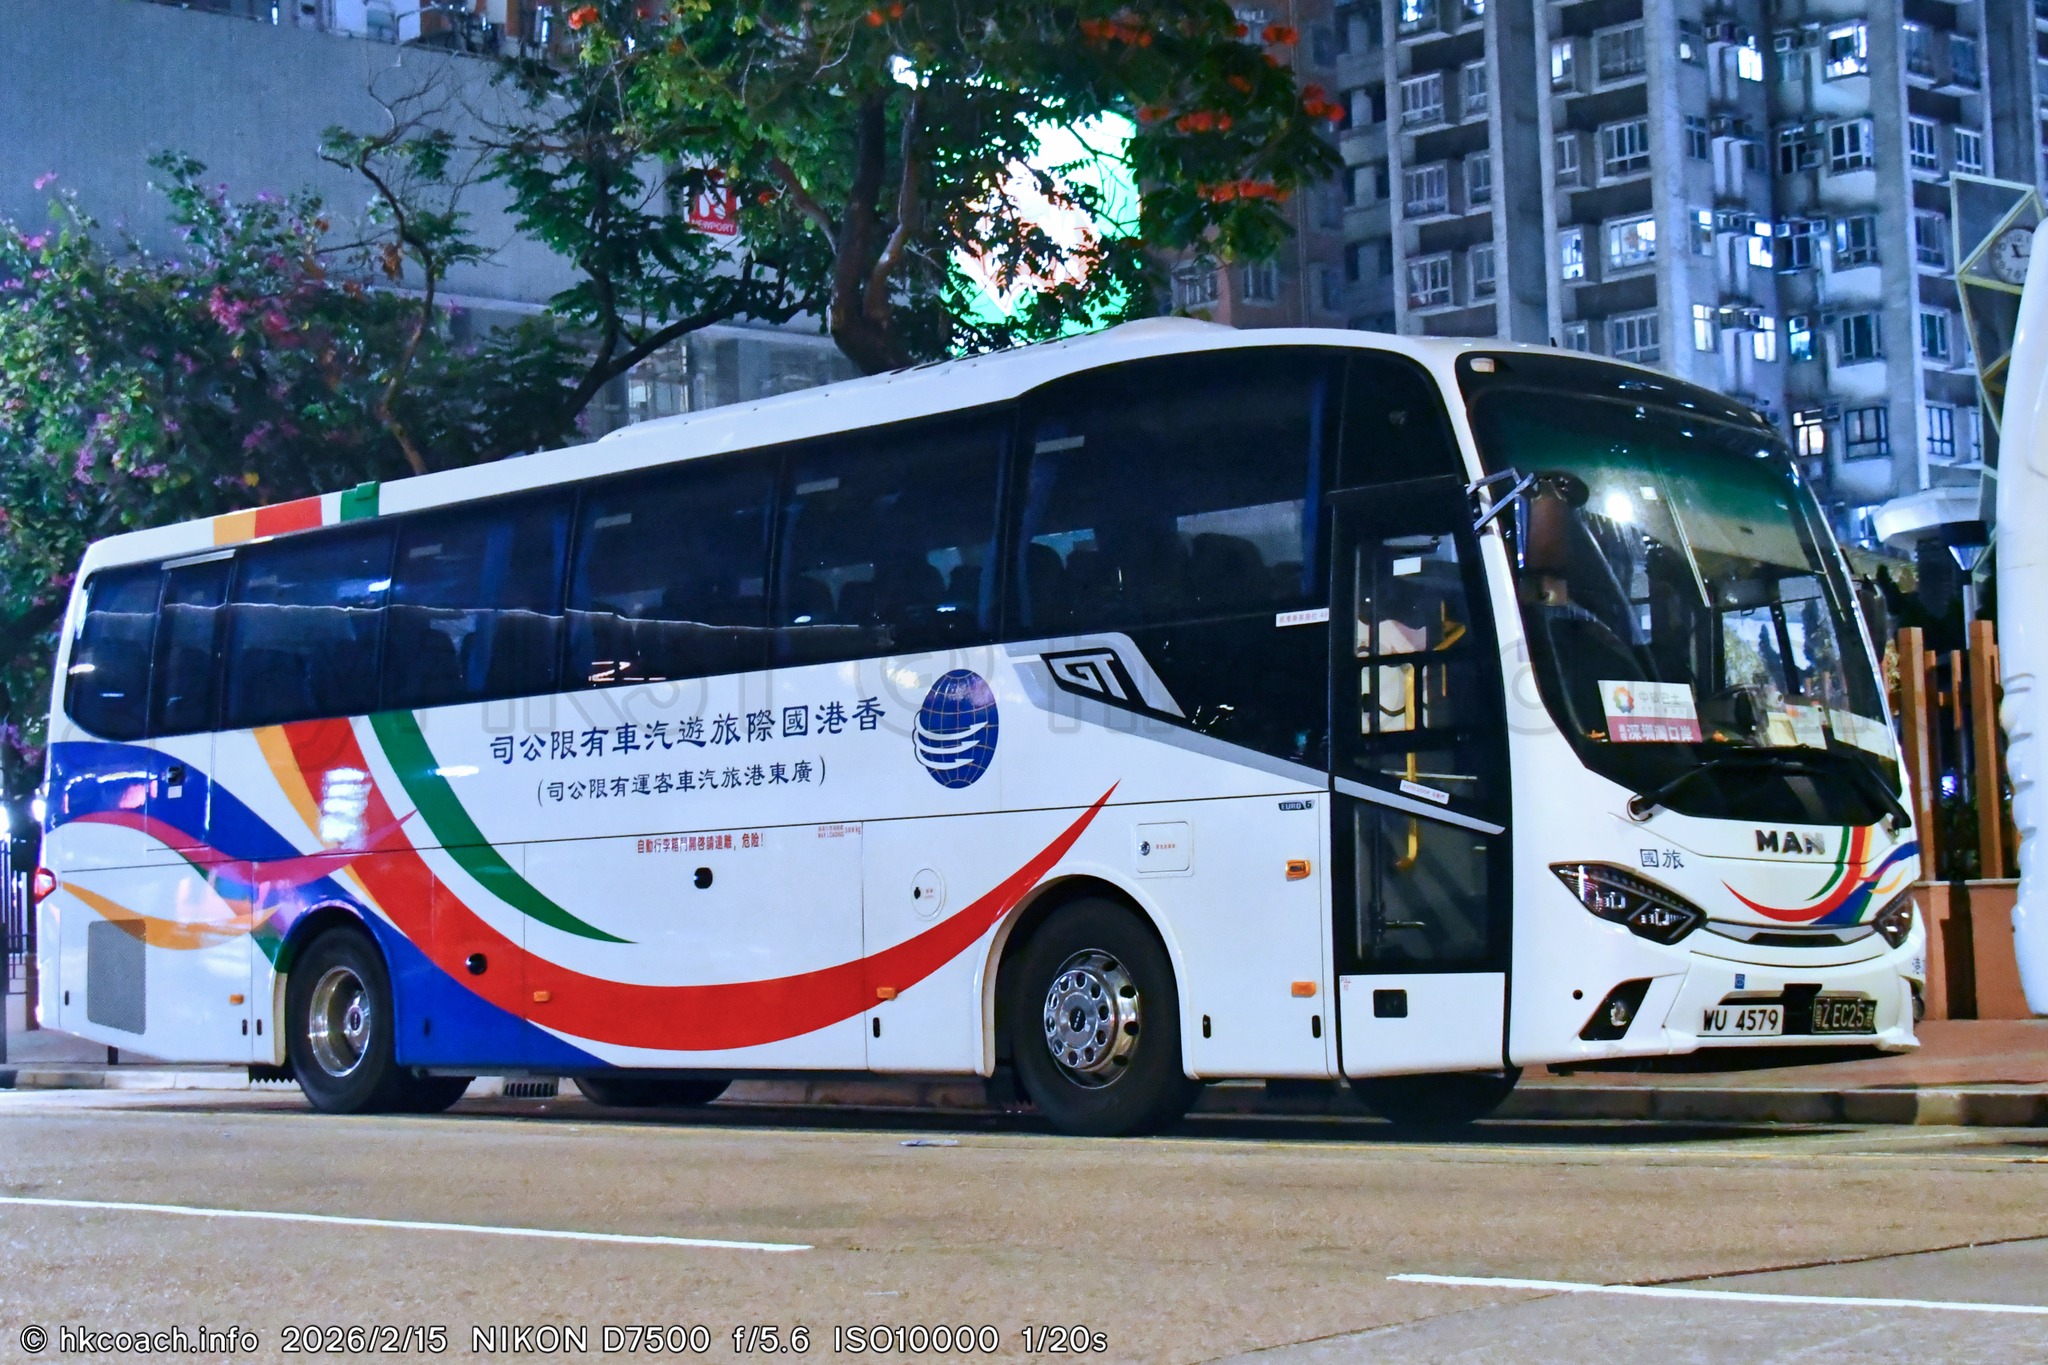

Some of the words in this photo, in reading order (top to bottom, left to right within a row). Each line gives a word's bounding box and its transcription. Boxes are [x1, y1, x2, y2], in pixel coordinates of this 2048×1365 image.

[1755, 830, 1826, 855] MAN
[1640, 848, 1685, 870] 國旅
[1703, 1009, 1727, 1031] WU
[1735, 1009, 1778, 1031] 4579
